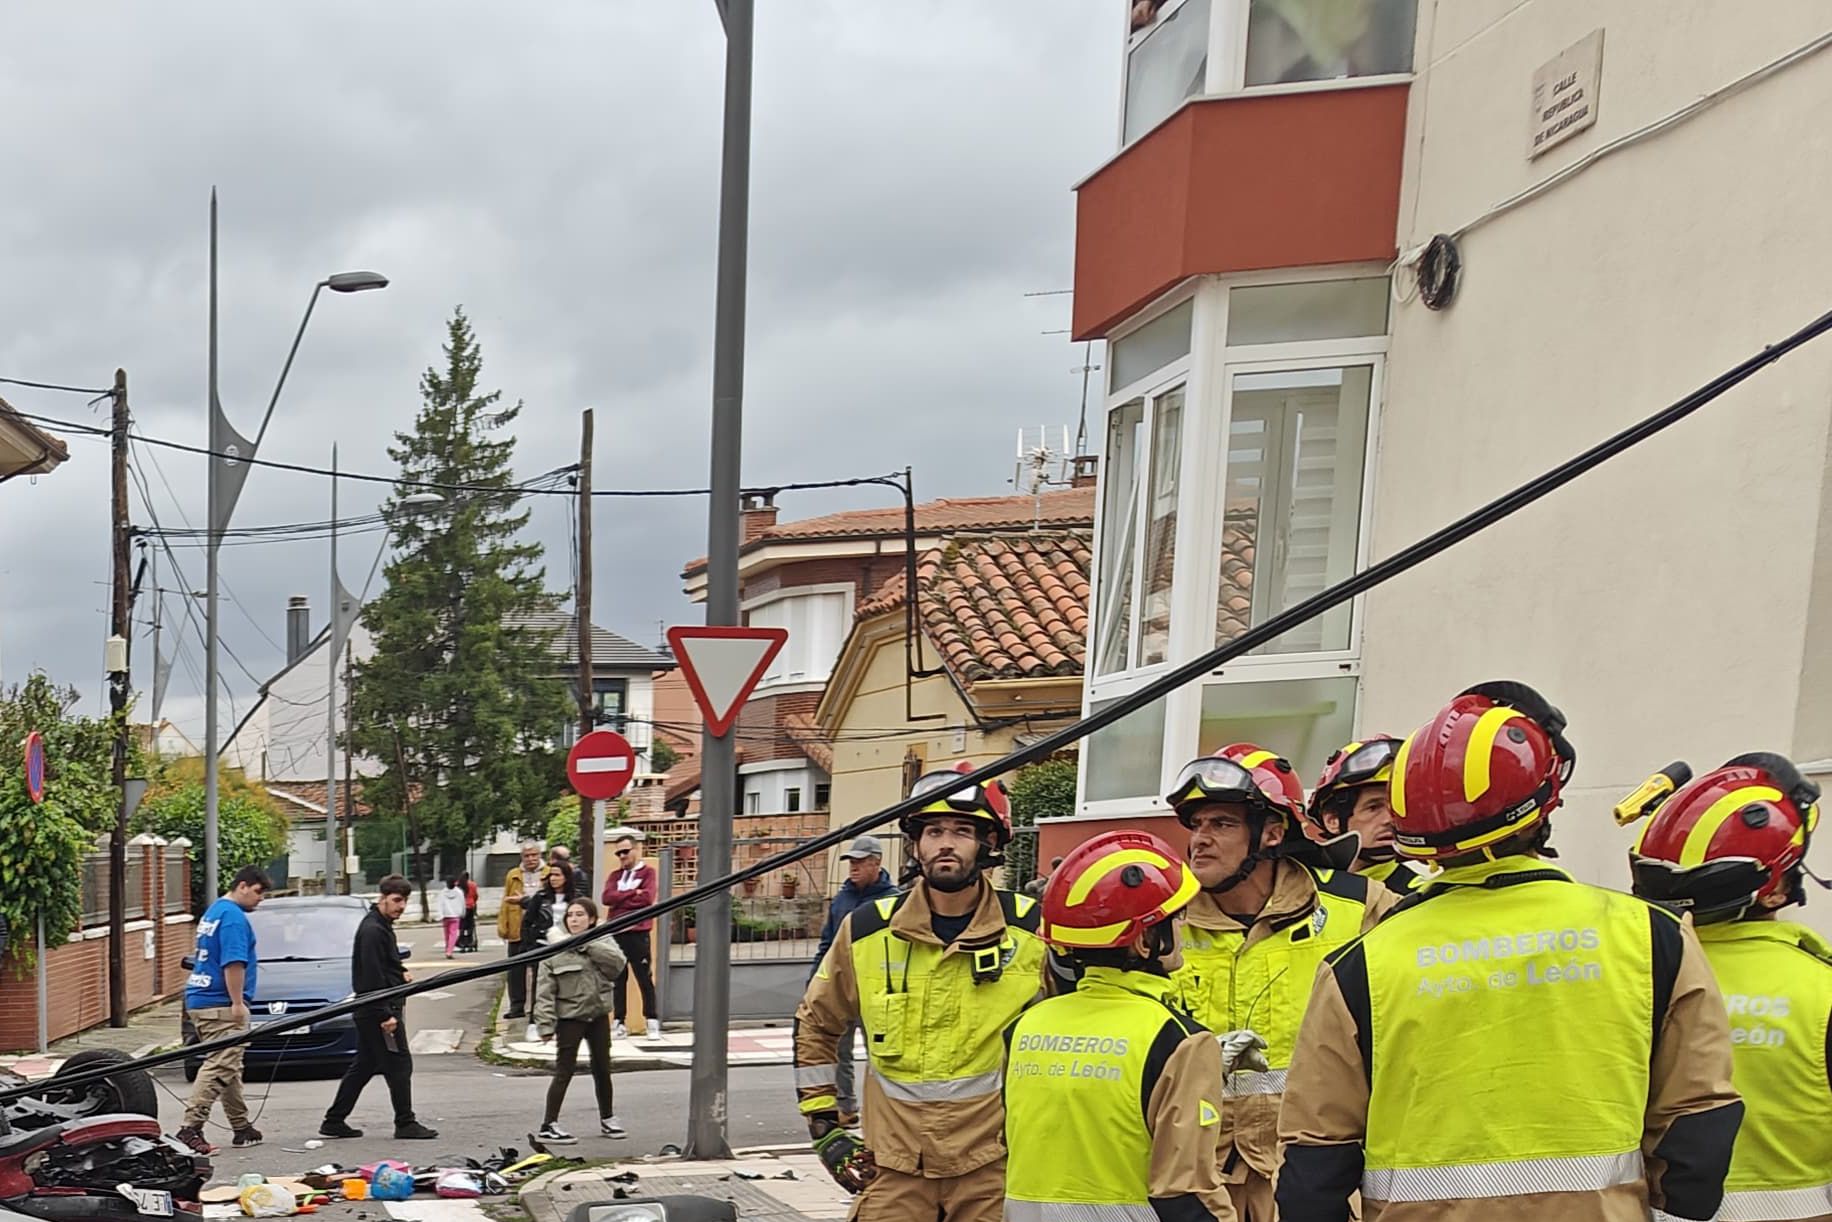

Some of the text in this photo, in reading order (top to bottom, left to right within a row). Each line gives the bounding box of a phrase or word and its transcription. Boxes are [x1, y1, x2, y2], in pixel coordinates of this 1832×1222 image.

[1553, 72, 1577, 96] CALLE
[1534, 131, 1545, 147] DE
[1416, 928, 1600, 967] BOMBEROS
[1487, 971, 1519, 990] de
[1526, 957, 1601, 985] León
[1017, 1034, 1129, 1056] BOMBEROS
[1047, 1061, 1066, 1077] de
[1069, 1059, 1121, 1081] León
